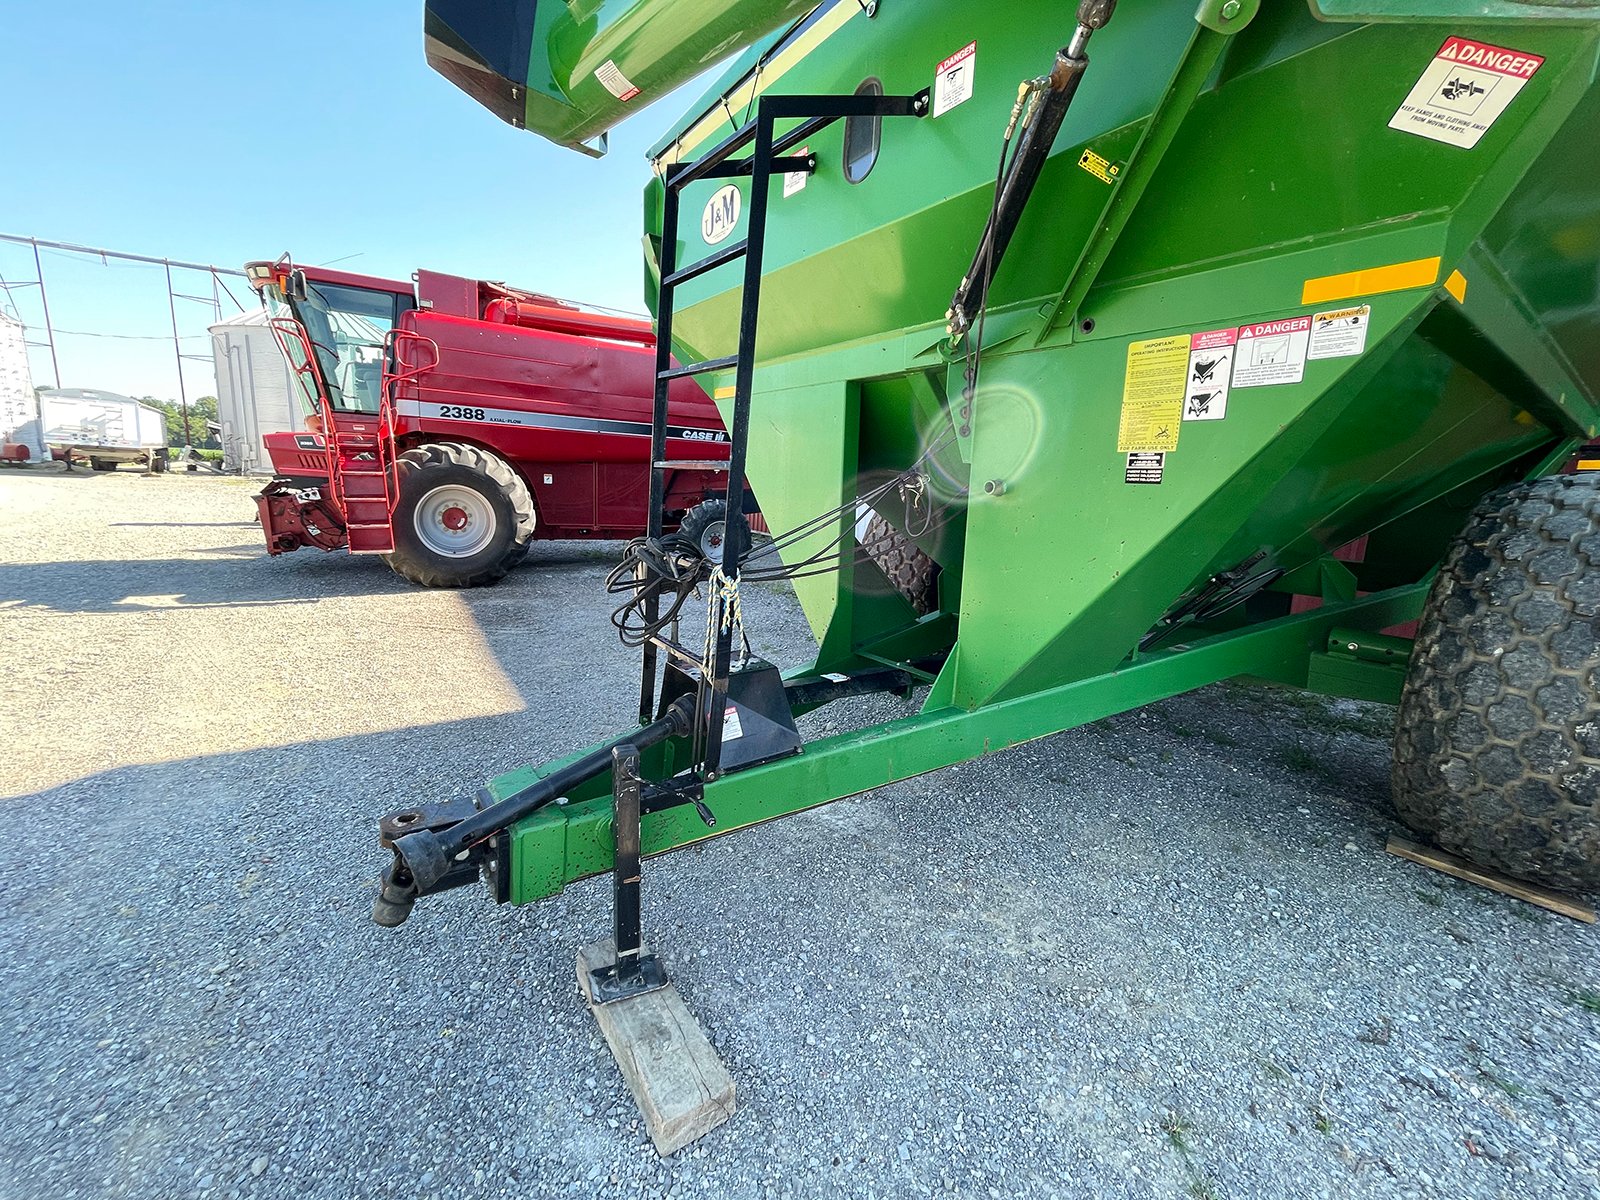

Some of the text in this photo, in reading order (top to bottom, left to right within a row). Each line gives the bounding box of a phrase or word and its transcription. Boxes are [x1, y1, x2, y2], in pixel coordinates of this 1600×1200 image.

[944, 44, 975, 68] DANGER
[1457, 45, 1539, 77] DANGER
[1415, 109, 1433, 117] HANDS
[1446, 116, 1471, 127] CLOTHING
[1426, 120, 1448, 129] MOVING
[1255, 320, 1309, 336] DANGER
[1206, 332, 1228, 340] DANGER
[1131, 349, 1155, 357] OPERATING
[1156, 345, 1189, 354] INSTRUCTIONS
[1144, 340, 1175, 349] IMPORTANT
[440, 405, 485, 421] 2388
[682, 430, 713, 441] CASE
